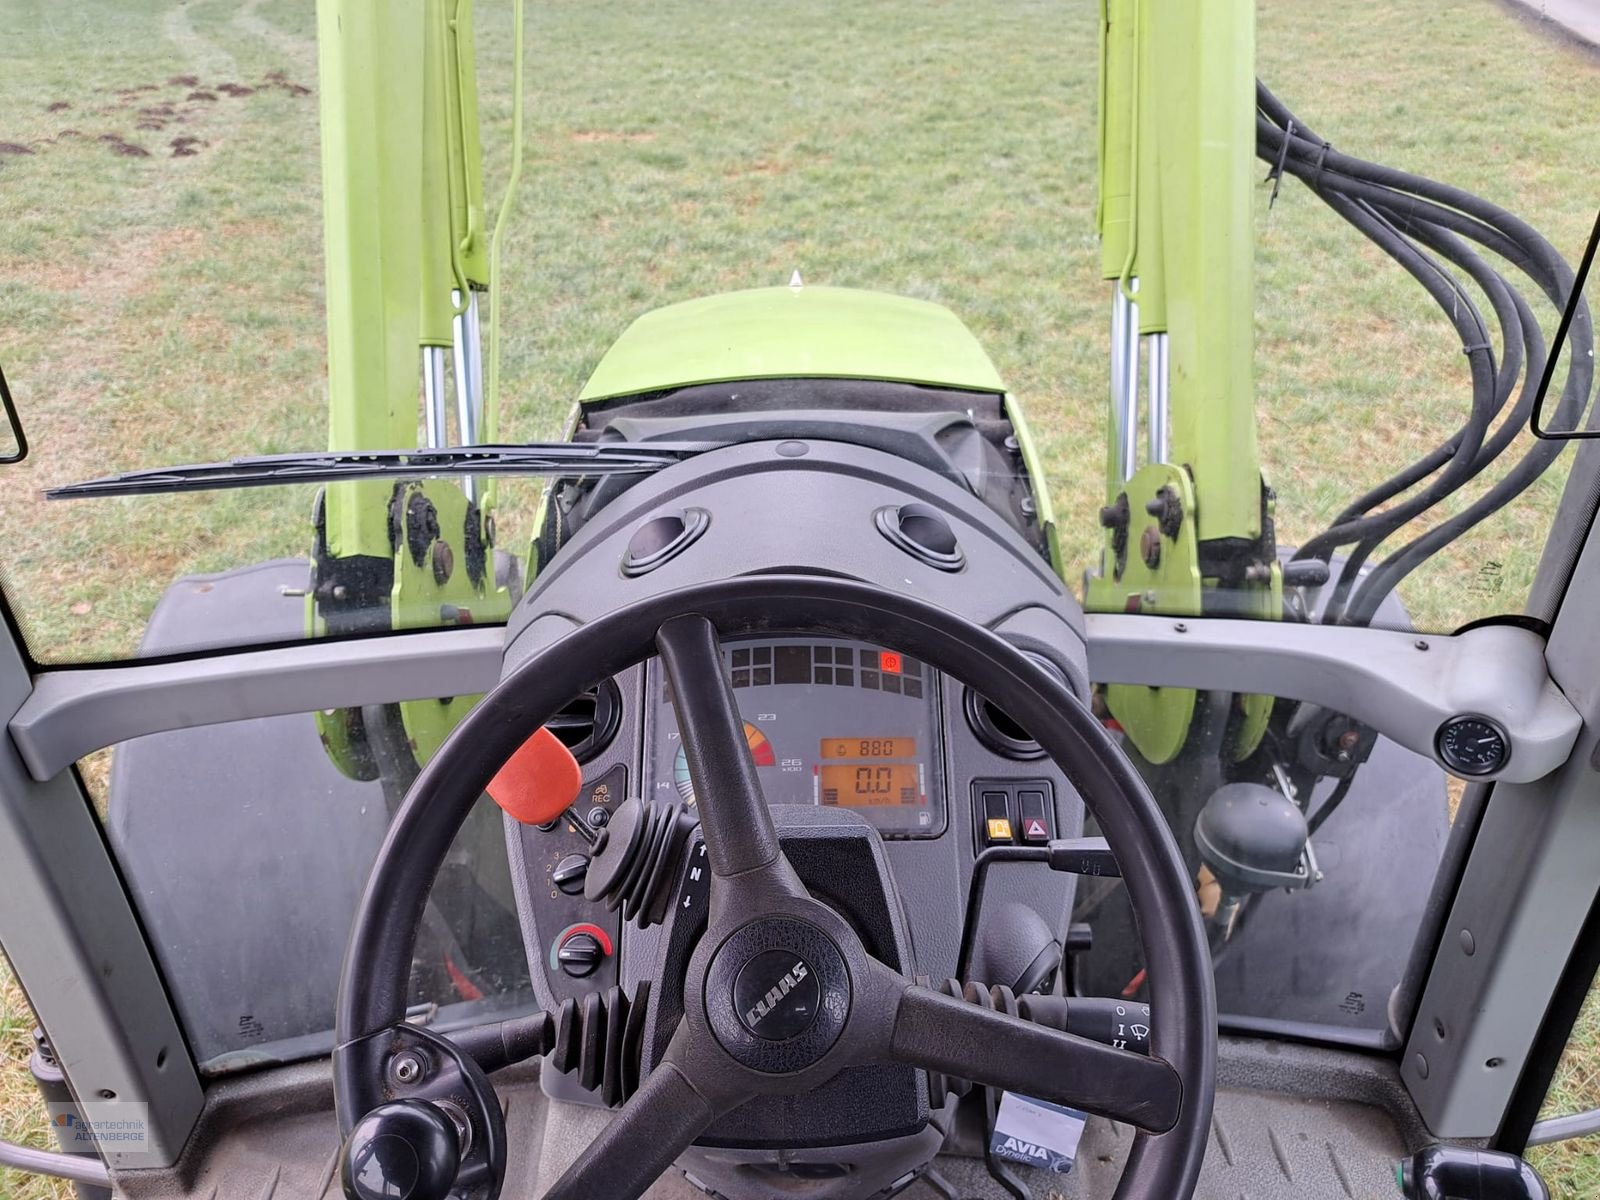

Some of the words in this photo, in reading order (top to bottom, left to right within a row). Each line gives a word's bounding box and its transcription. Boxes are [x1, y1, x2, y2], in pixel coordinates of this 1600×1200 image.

[757, 713, 777, 721] 23
[859, 740, 893, 756] 880
[855, 767, 892, 794] 0.0
[592, 794, 611, 803] REC
[553, 851, 560, 860] 3
[546, 864, 552, 873] 2
[690, 866, 702, 882] N
[745, 960, 808, 1028] CLAAS
[1003, 1137, 1048, 1160] AVIA
